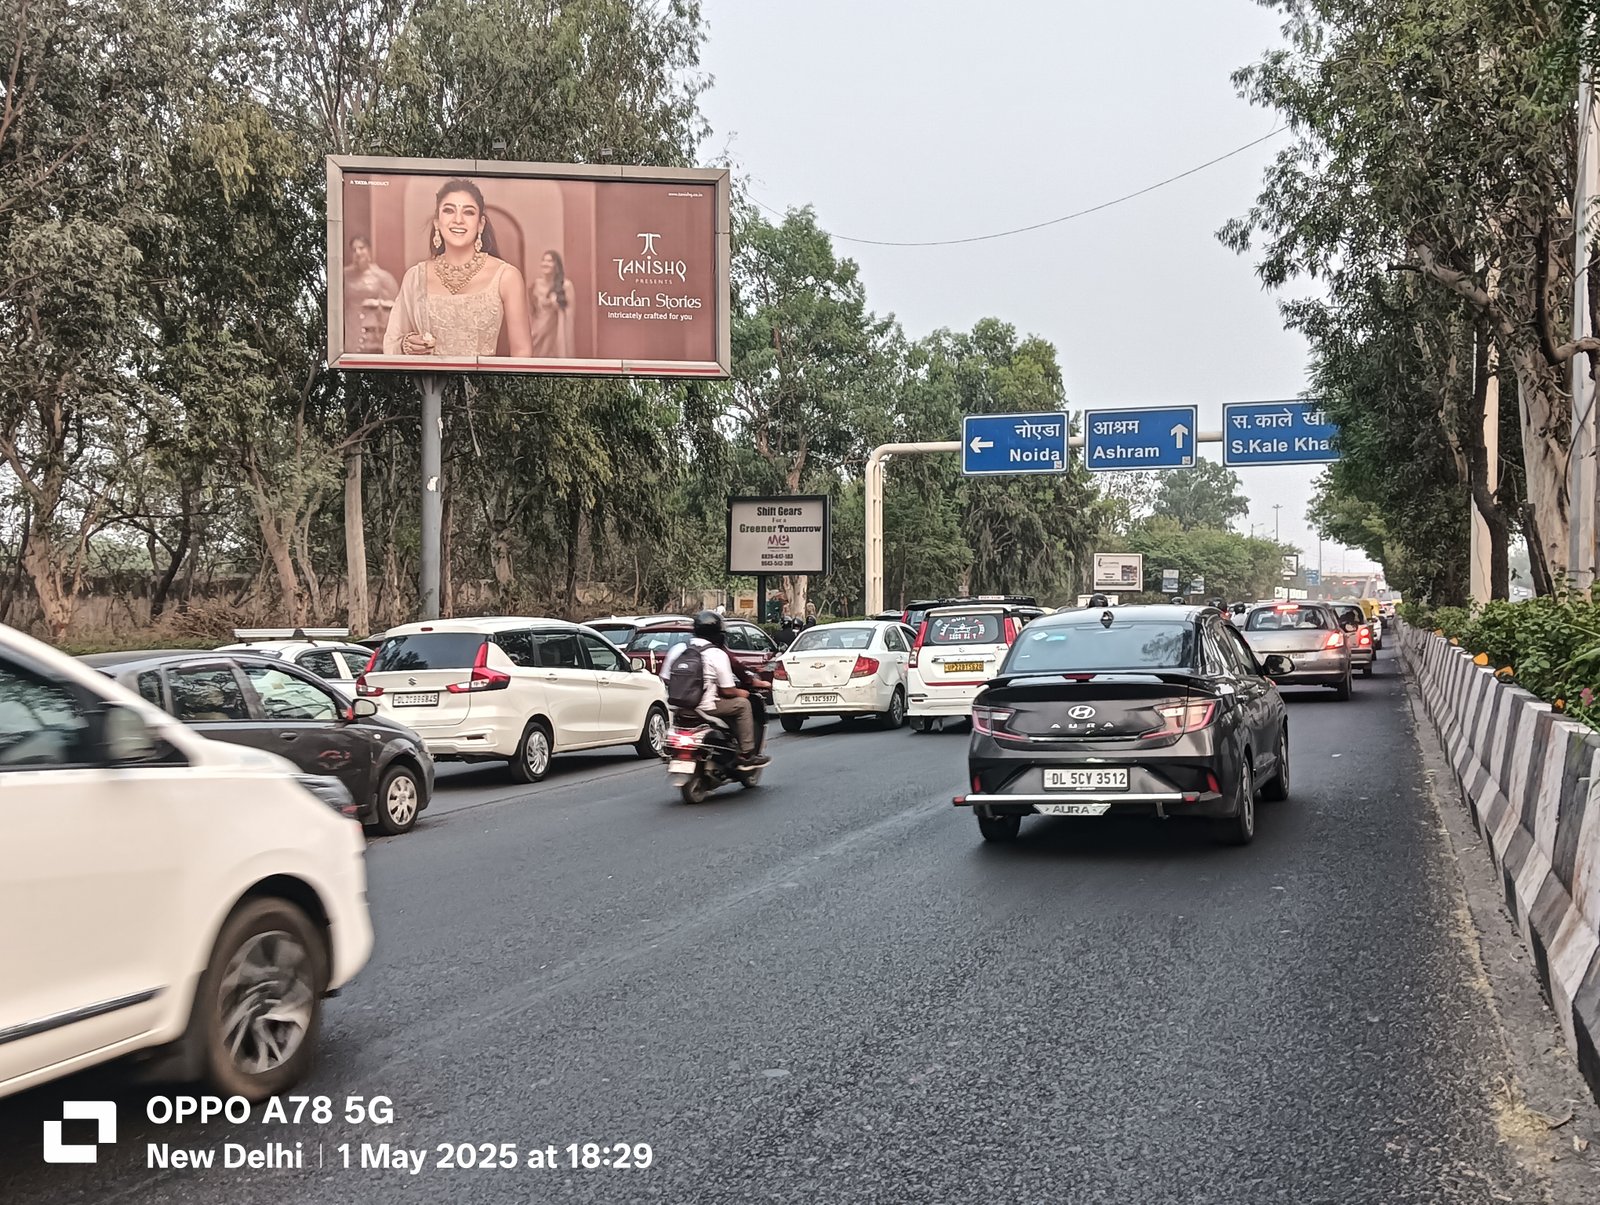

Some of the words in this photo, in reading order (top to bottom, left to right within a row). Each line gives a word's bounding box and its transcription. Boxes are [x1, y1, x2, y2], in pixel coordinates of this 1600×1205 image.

[598, 290, 650, 306] Kundan
[655, 292, 702, 309] Stories
[1254, 408, 1294, 428] काले
[1014, 420, 1060, 440] नोएडा
[1093, 420, 1140, 435] आश्रम
[1092, 444, 1160, 460] Ashram
[1294, 437, 1337, 452] Kha
[1010, 448, 1060, 462] Noida
[757, 506, 776, 516] Shift
[778, 506, 802, 516] Gears
[740, 524, 776, 533] Greener
[778, 524, 822, 533] Tomorrow
[1052, 773, 1066, 784] DL
[1071, 773, 1092, 784] 5CY
[1096, 772, 1126, 784] 3512
[1053, 806, 1090, 814] AURA
